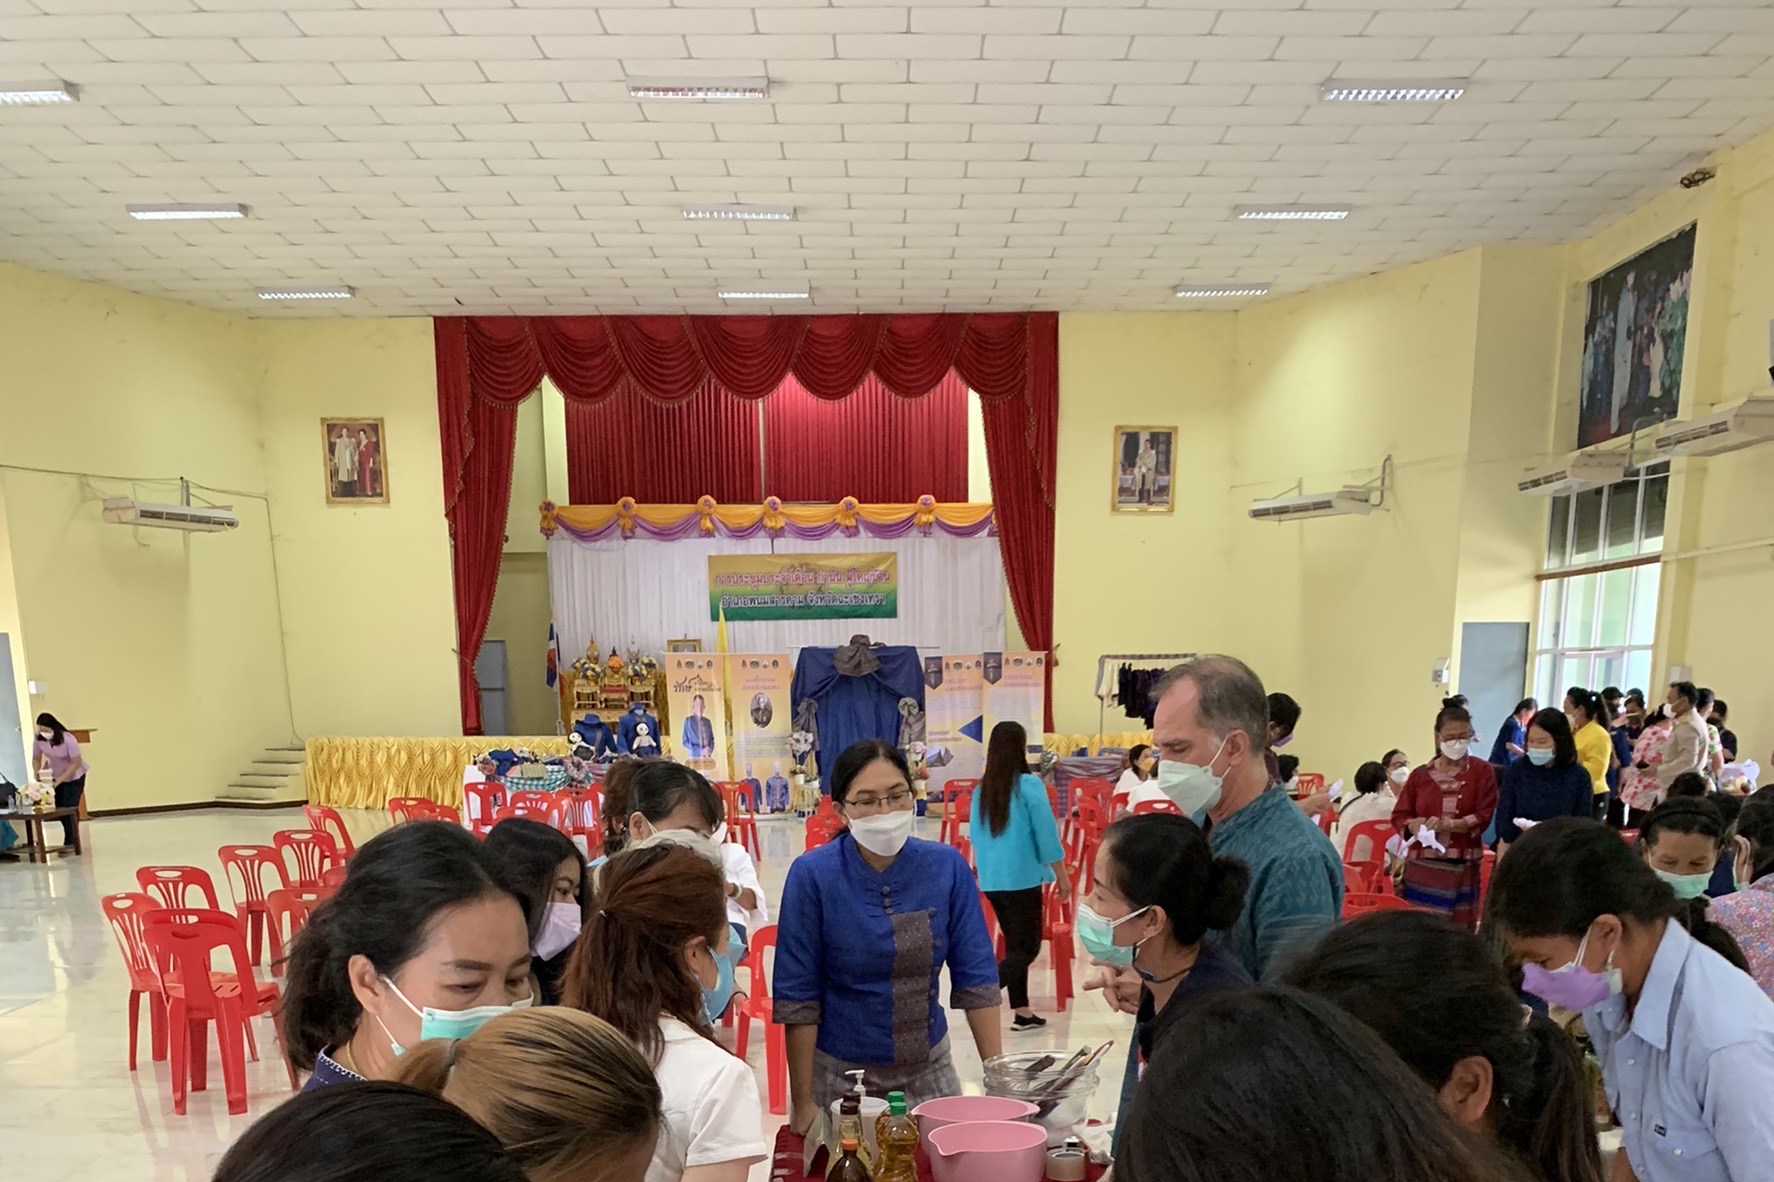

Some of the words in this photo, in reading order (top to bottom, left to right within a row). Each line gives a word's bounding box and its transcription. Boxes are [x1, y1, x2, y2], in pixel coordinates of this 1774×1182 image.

[807, 590, 887, 606] จังหวัดฉะเชิงเทรา
